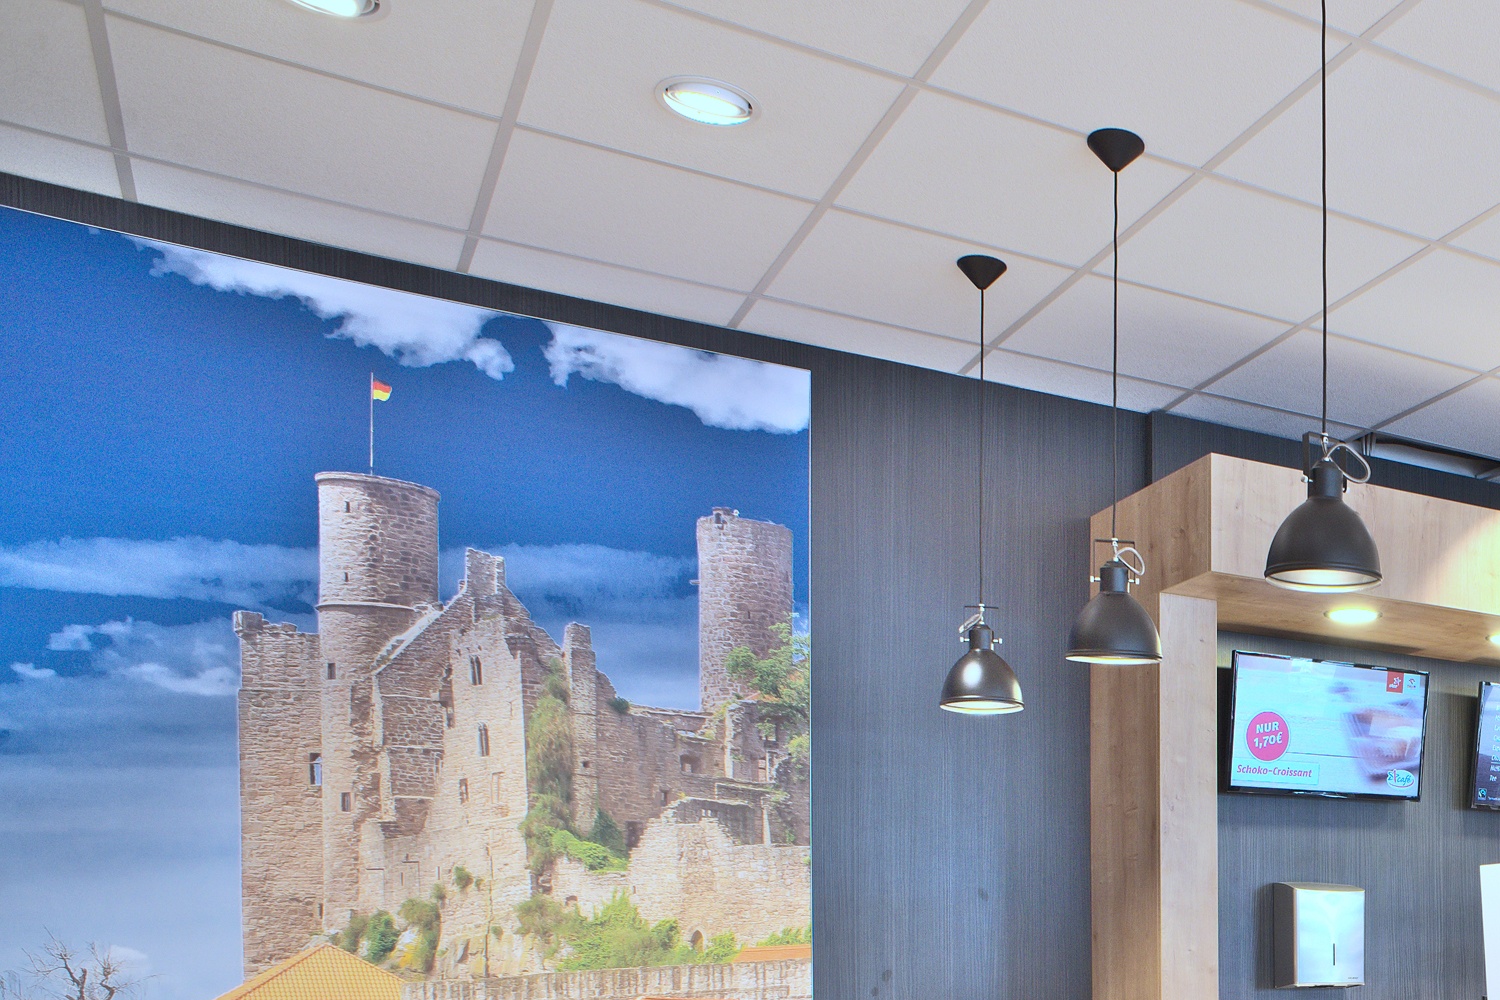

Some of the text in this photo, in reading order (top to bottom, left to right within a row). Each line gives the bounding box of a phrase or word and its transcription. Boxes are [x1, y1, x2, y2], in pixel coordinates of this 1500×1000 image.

[1255, 721, 1279, 734] NUR
[1253, 732, 1283, 749] 1,70€
[1236, 764, 1312, 778] Schoko-Croissant
